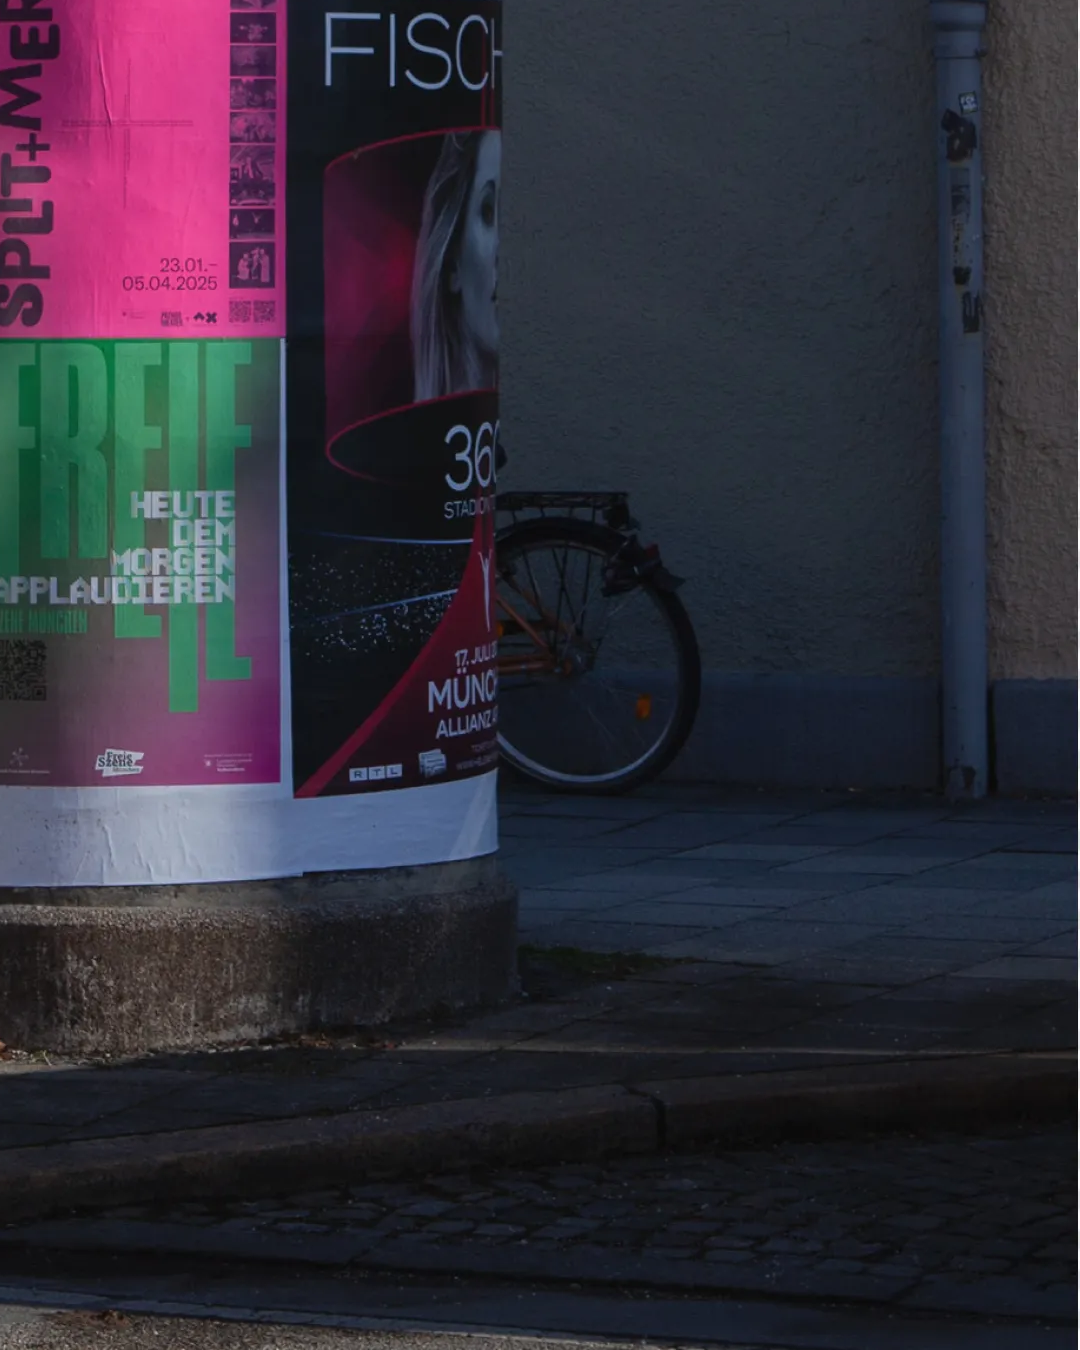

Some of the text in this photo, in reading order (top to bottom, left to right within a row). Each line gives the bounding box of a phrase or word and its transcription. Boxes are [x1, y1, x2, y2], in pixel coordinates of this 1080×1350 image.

[122, 275, 218, 291] 05.04.2025
[130, 490, 236, 519] HEUTE
[172, 519, 236, 547] DEM
[111, 548, 236, 576] MORGEN
[28, 607, 88, 634] MÜNCHEN
[353, 766, 399, 780] RTL
